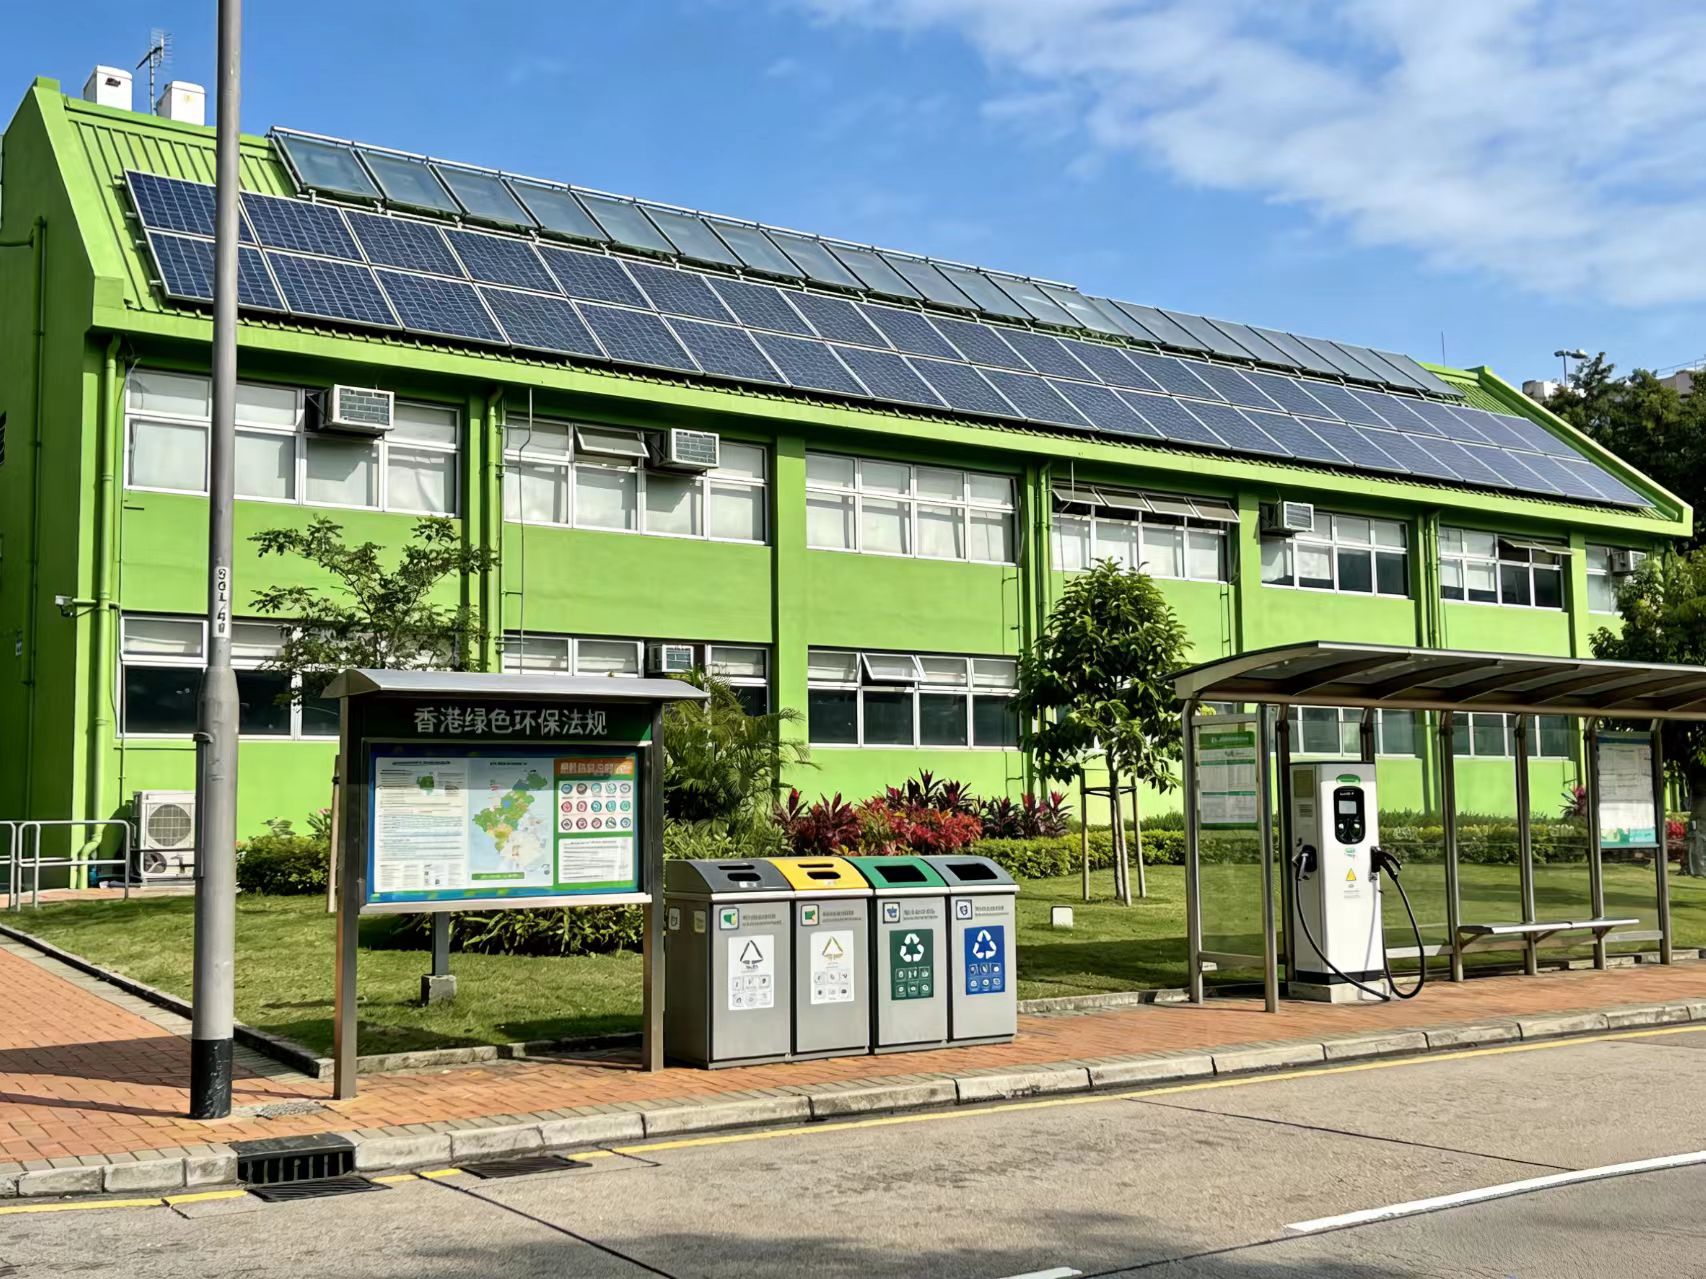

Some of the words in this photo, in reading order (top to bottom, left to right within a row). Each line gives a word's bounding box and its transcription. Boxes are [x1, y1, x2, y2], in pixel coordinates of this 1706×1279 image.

[414, 706, 608, 736] 香港绿色环保法规
